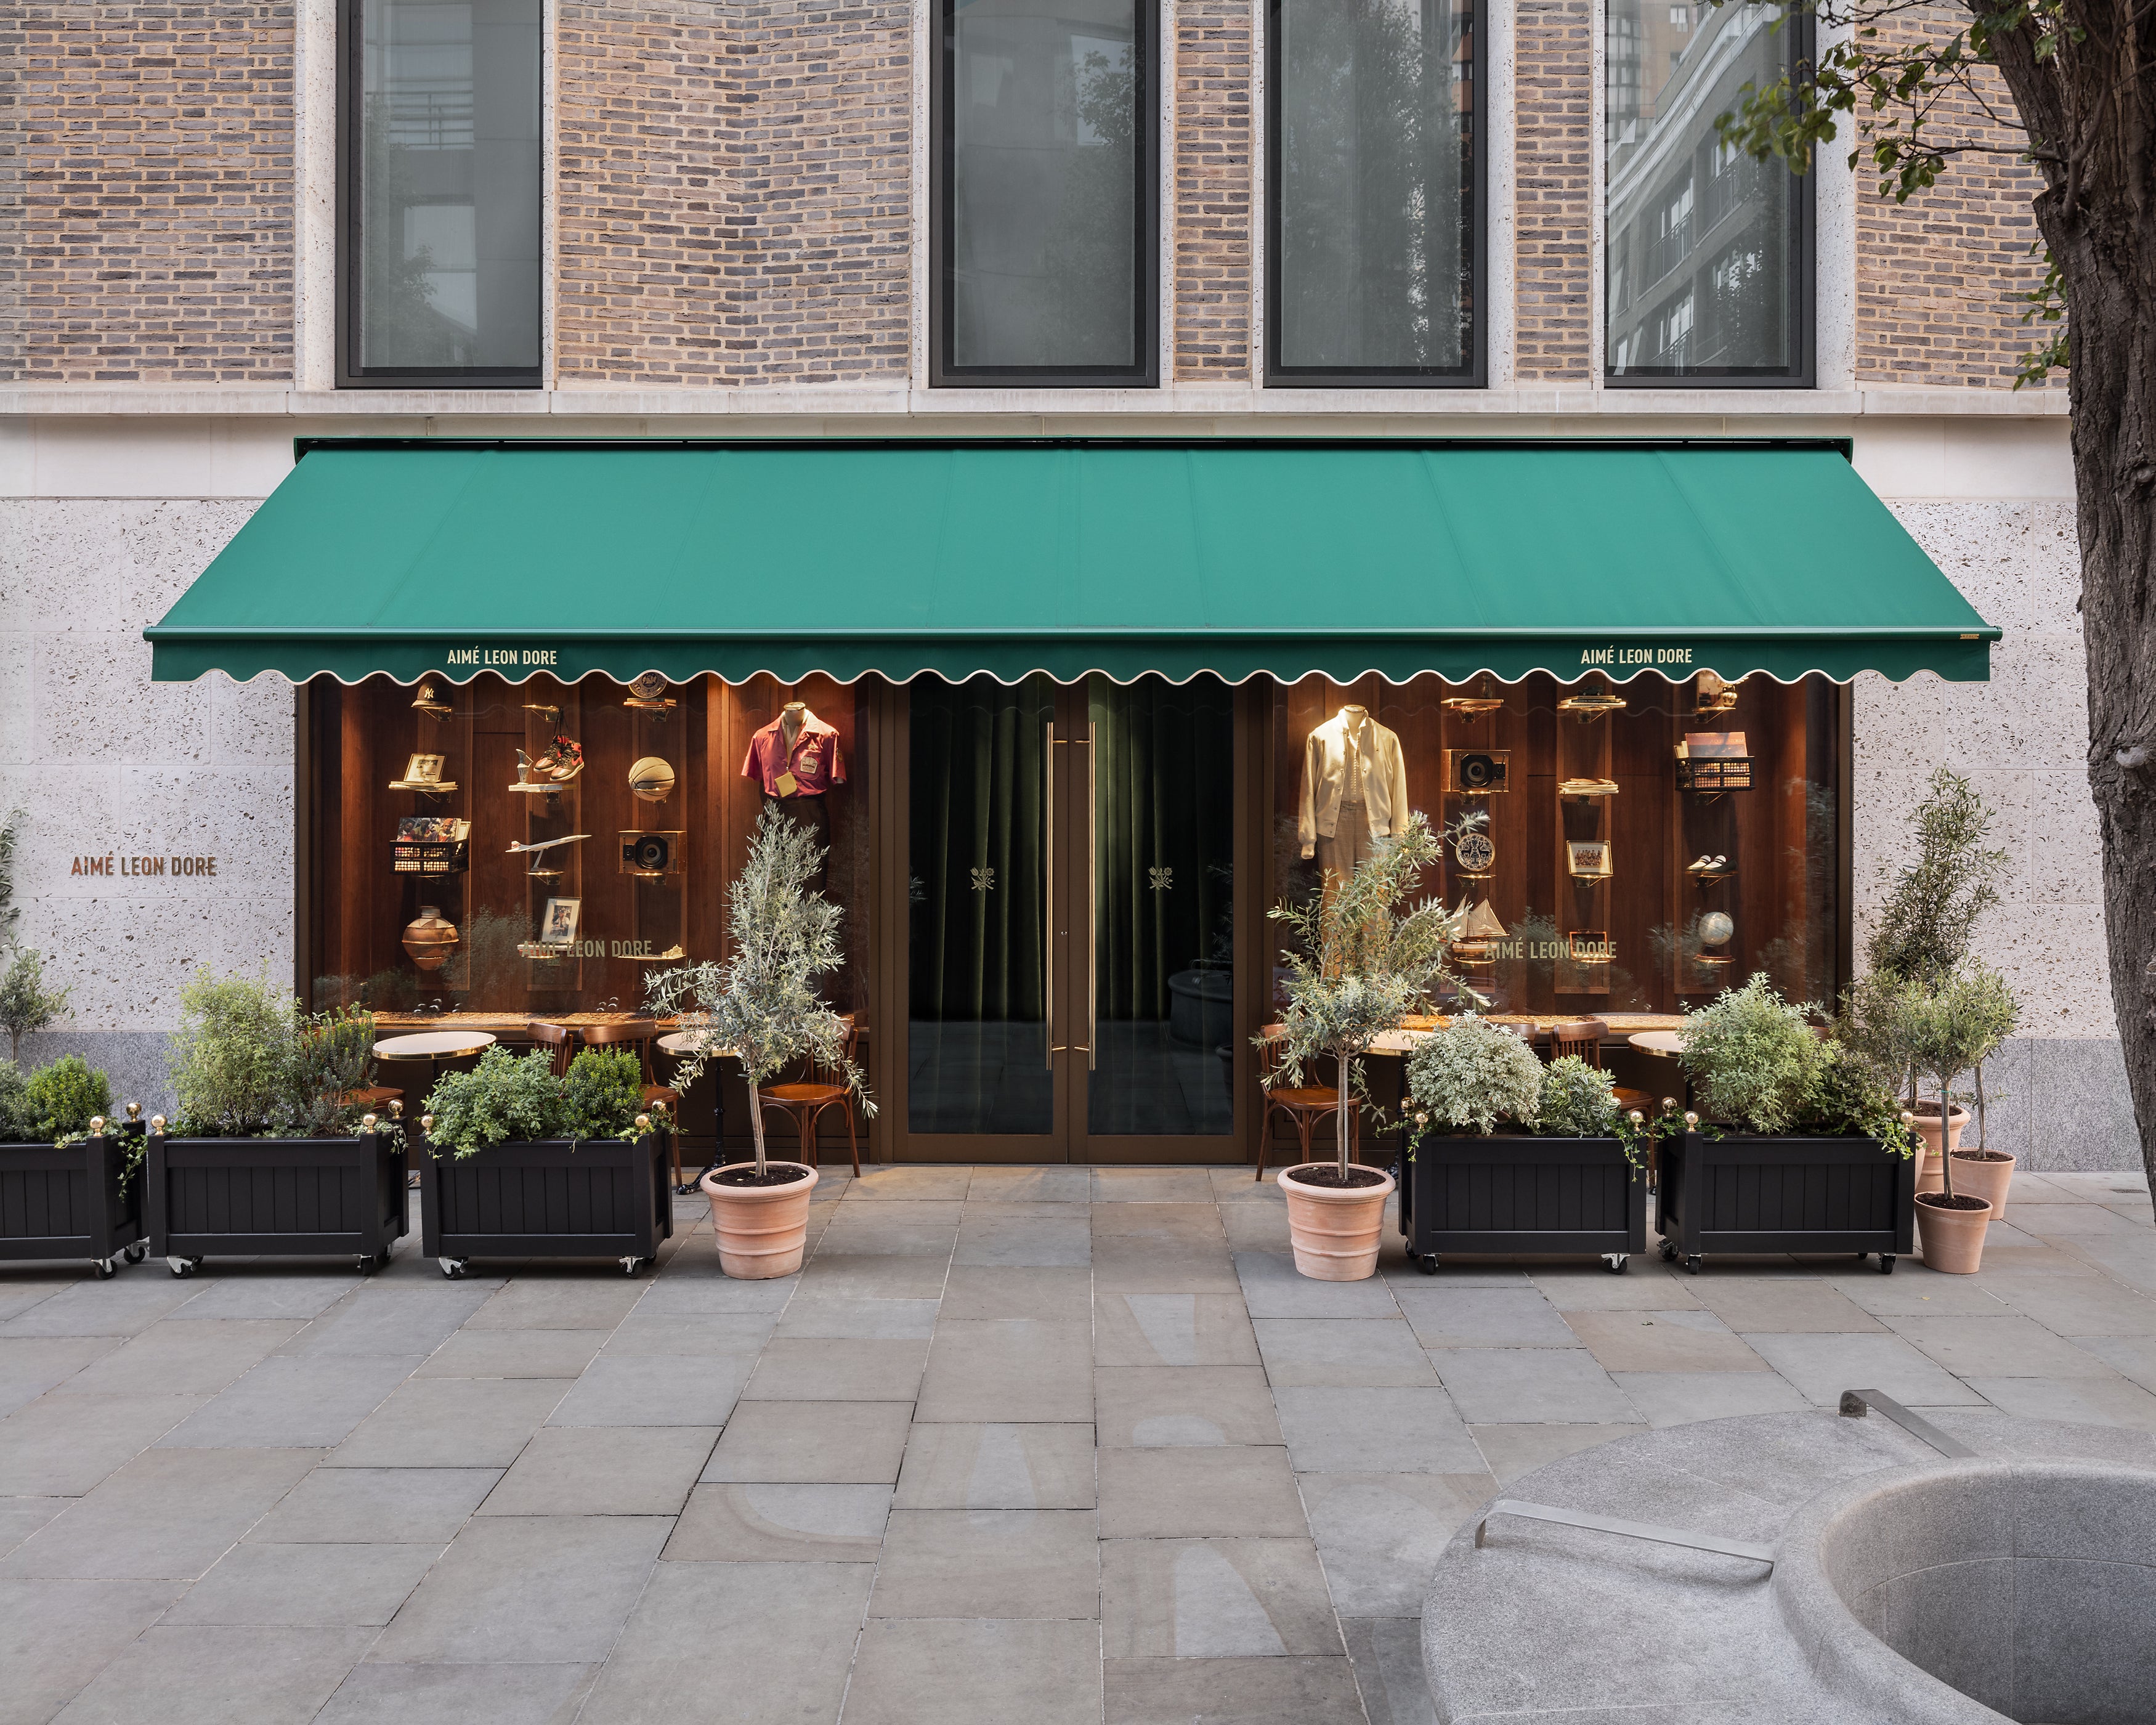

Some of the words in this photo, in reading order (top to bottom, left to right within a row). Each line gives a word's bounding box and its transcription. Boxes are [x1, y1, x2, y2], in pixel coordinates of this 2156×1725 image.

[447, 646, 480, 664] AIMÉ
[485, 650, 517, 664] LEON
[523, 650, 557, 665] DORE
[1581, 645, 1614, 664] AIMÉ
[1619, 649, 1653, 664] LEON
[1658, 649, 1692, 664] DORE
[71, 851, 114, 876] AIMÉ
[121, 856, 164, 876] LEON
[171, 856, 217, 876] DORE
[567, 940, 605, 957] LEON
[612, 940, 652, 957] DORE
[1484, 936, 1523, 959] AIMÉ
[1530, 941, 1570, 959] LEON
[1576, 941, 1617, 959] DORE
